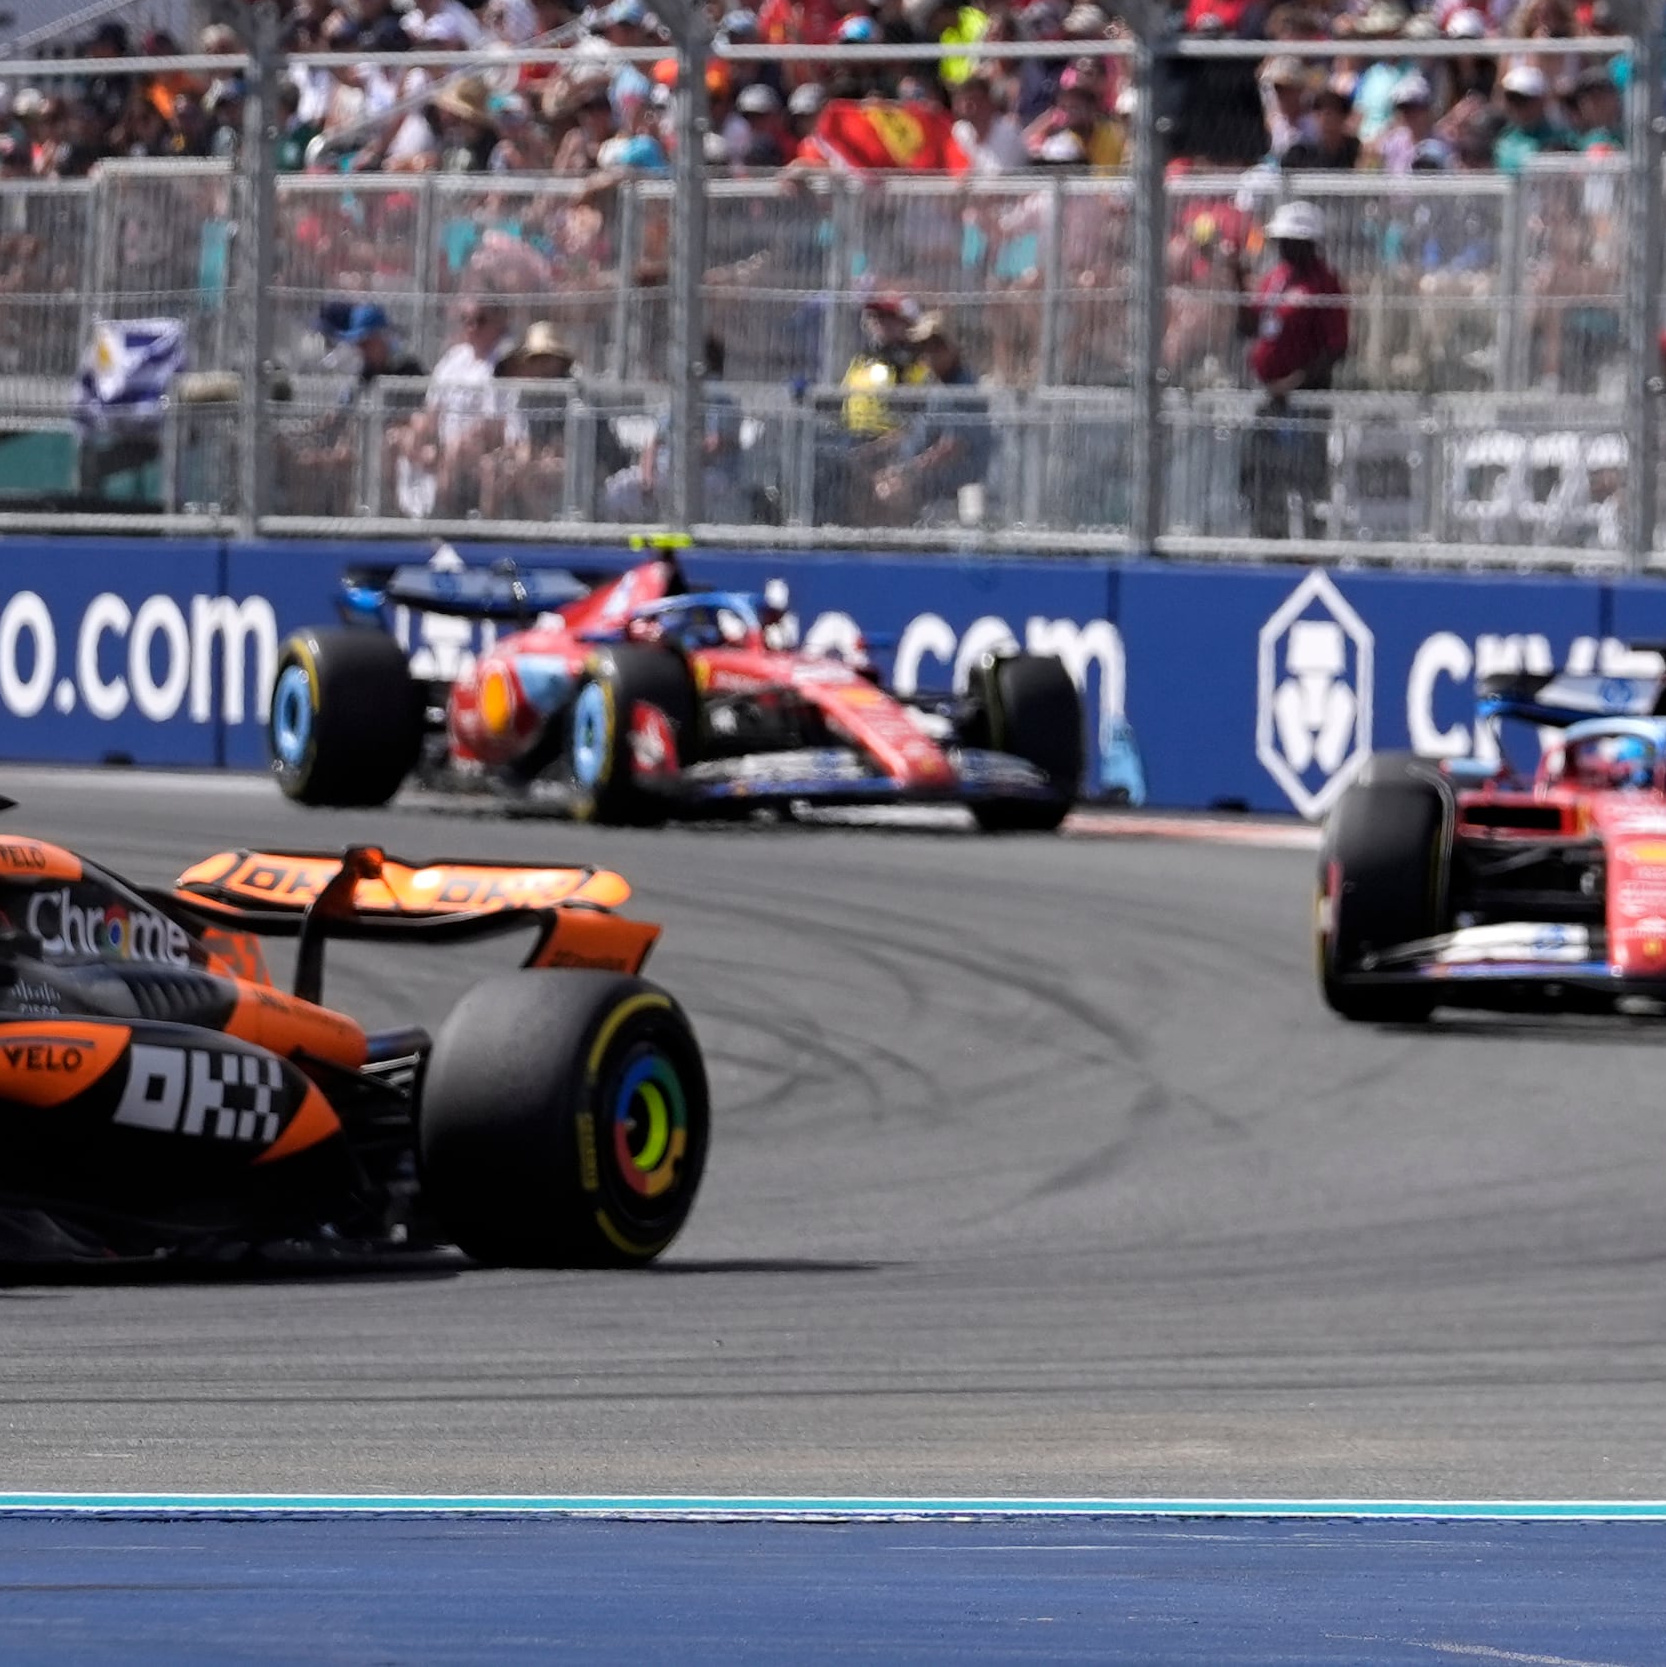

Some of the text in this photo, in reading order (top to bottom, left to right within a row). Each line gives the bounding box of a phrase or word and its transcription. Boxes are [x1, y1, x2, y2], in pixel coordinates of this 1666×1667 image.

[27, 887, 191, 971] Chrome
[2, 1046, 83, 1073] VELO
[113, 1043, 283, 1143] OKX
